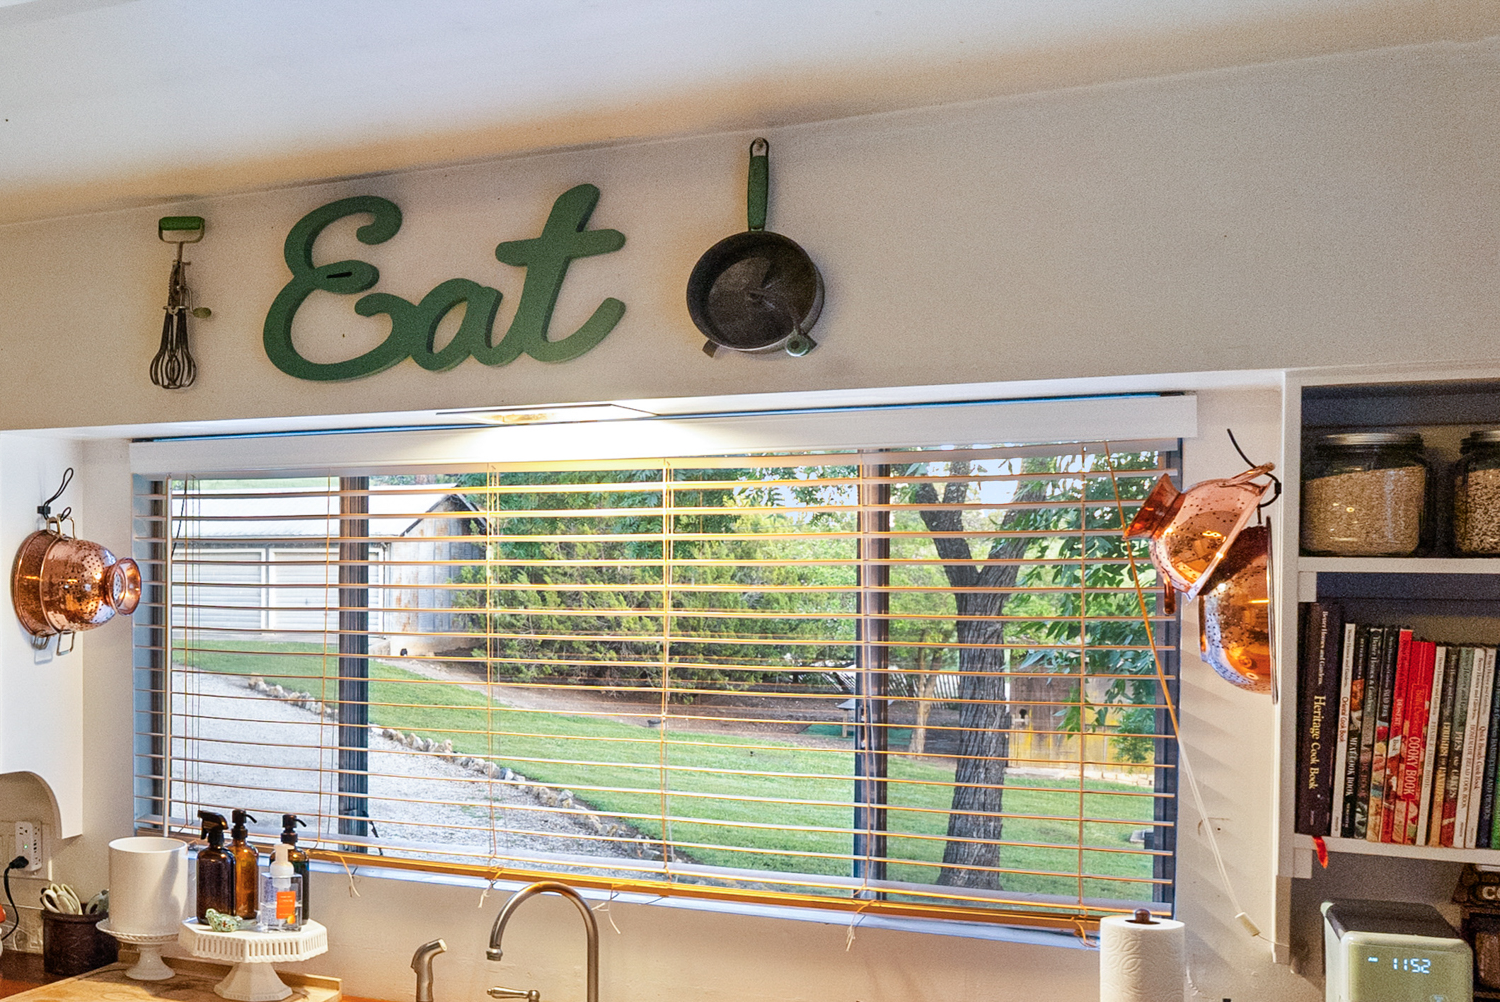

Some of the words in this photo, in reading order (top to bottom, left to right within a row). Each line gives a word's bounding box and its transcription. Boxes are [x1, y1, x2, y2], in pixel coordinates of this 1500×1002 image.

[262, 182, 626, 382] Eat
[1321, 611, 1329, 628] Better
[1320, 628, 1328, 648] Homes
[1371, 636, 1381, 655] Better
[1369, 657, 1379, 678] Homes
[1341, 696, 1350, 716] Oriental
[1310, 695, 1326, 740] Heritage
[1340, 716, 1348, 730] Cook
[1440, 722, 1452, 756] COOKIES
[1454, 731, 1464, 751] PIES
[1468, 724, 1476, 756] HOMEMADE
[1478, 726, 1487, 742] Quick
[1310, 742, 1321, 765] Cook
[1348, 736, 1358, 756] MEAT
[1406, 736, 1421, 768] COOKY
[1347, 755, 1356, 776] COOK
[1464, 757, 1473, 776] BREAD
[1475, 761, 1483, 775] Cook
[1308, 767, 1320, 790] Book
[1345, 776, 1354, 796] BOOK
[1403, 769, 1417, 796] BOOK
[1436, 766, 1447, 802] CANDIES
[1449, 769, 1459, 799] CAKES
[1473, 776, 1482, 790] Book
